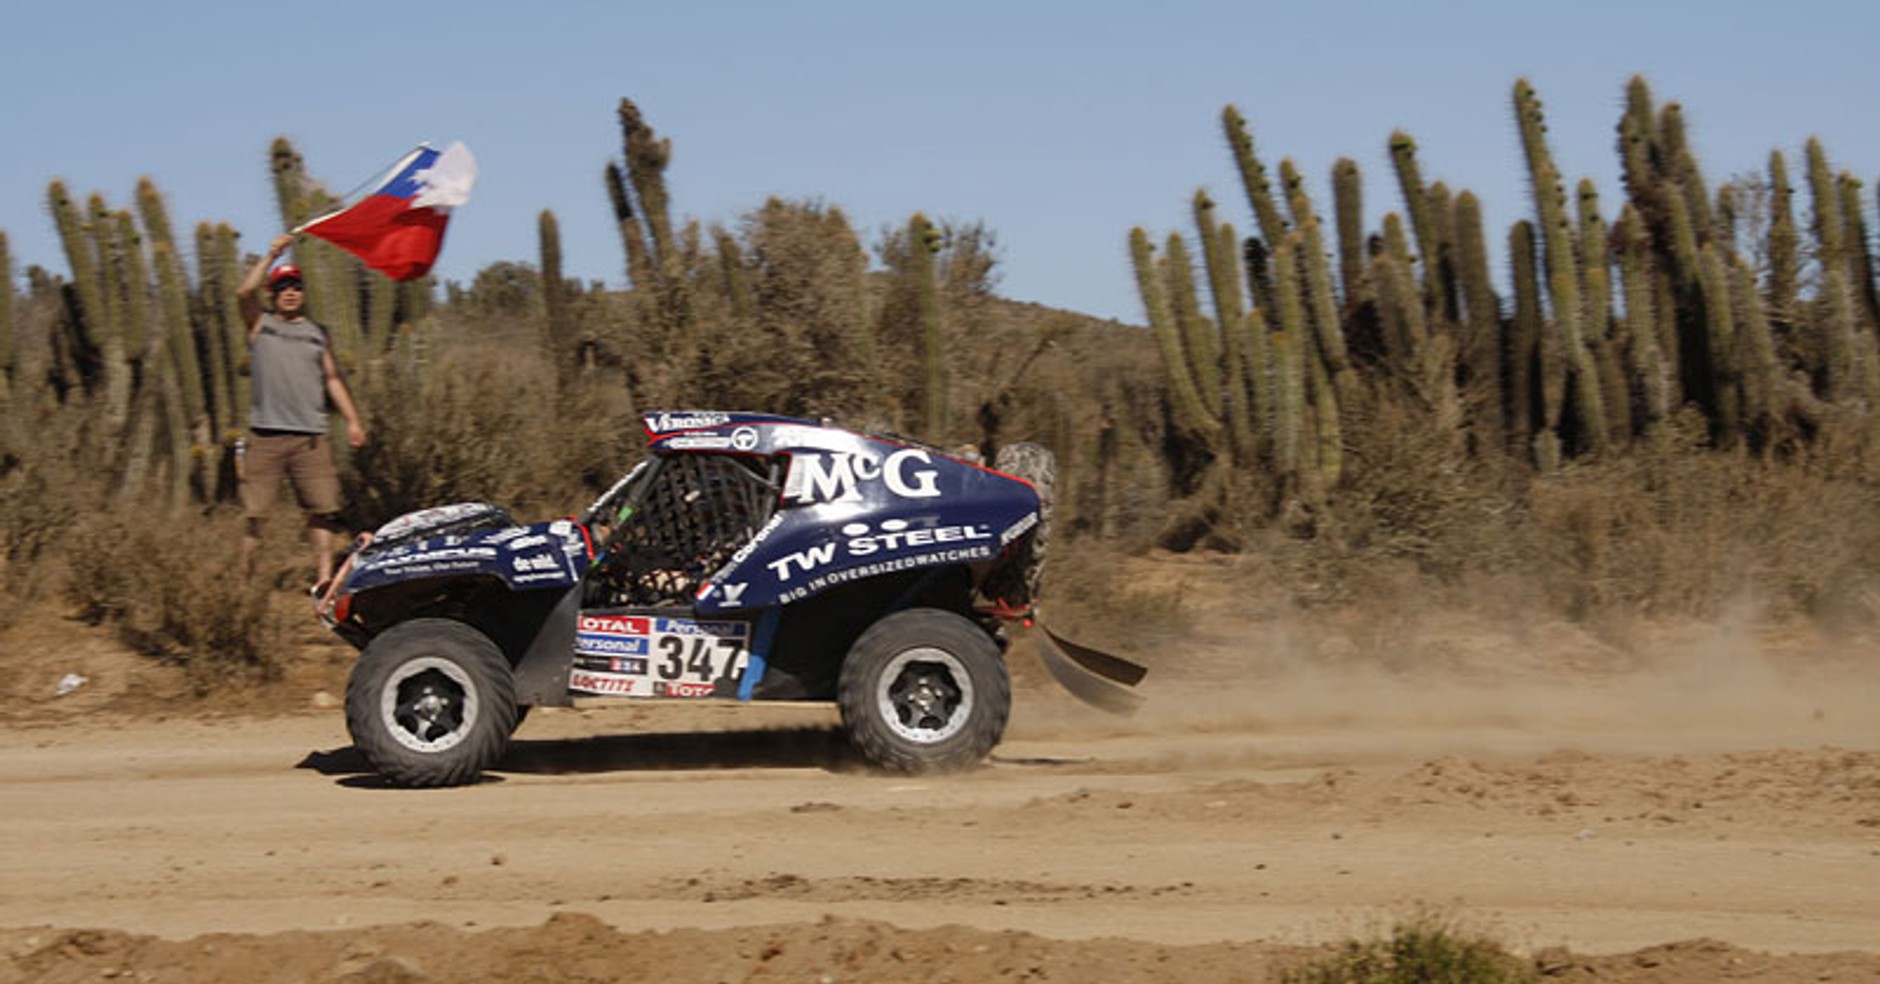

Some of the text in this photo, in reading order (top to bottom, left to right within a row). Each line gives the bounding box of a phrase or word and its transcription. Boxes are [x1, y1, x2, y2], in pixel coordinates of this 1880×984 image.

[797, 449, 942, 503] McG
[732, 513, 784, 563] Coronel
[767, 542, 836, 581] TW
[848, 525, 992, 555] STEEL
[779, 585, 808, 604] BIG
[809, 574, 827, 590] IN
[658, 634, 744, 681] 347
